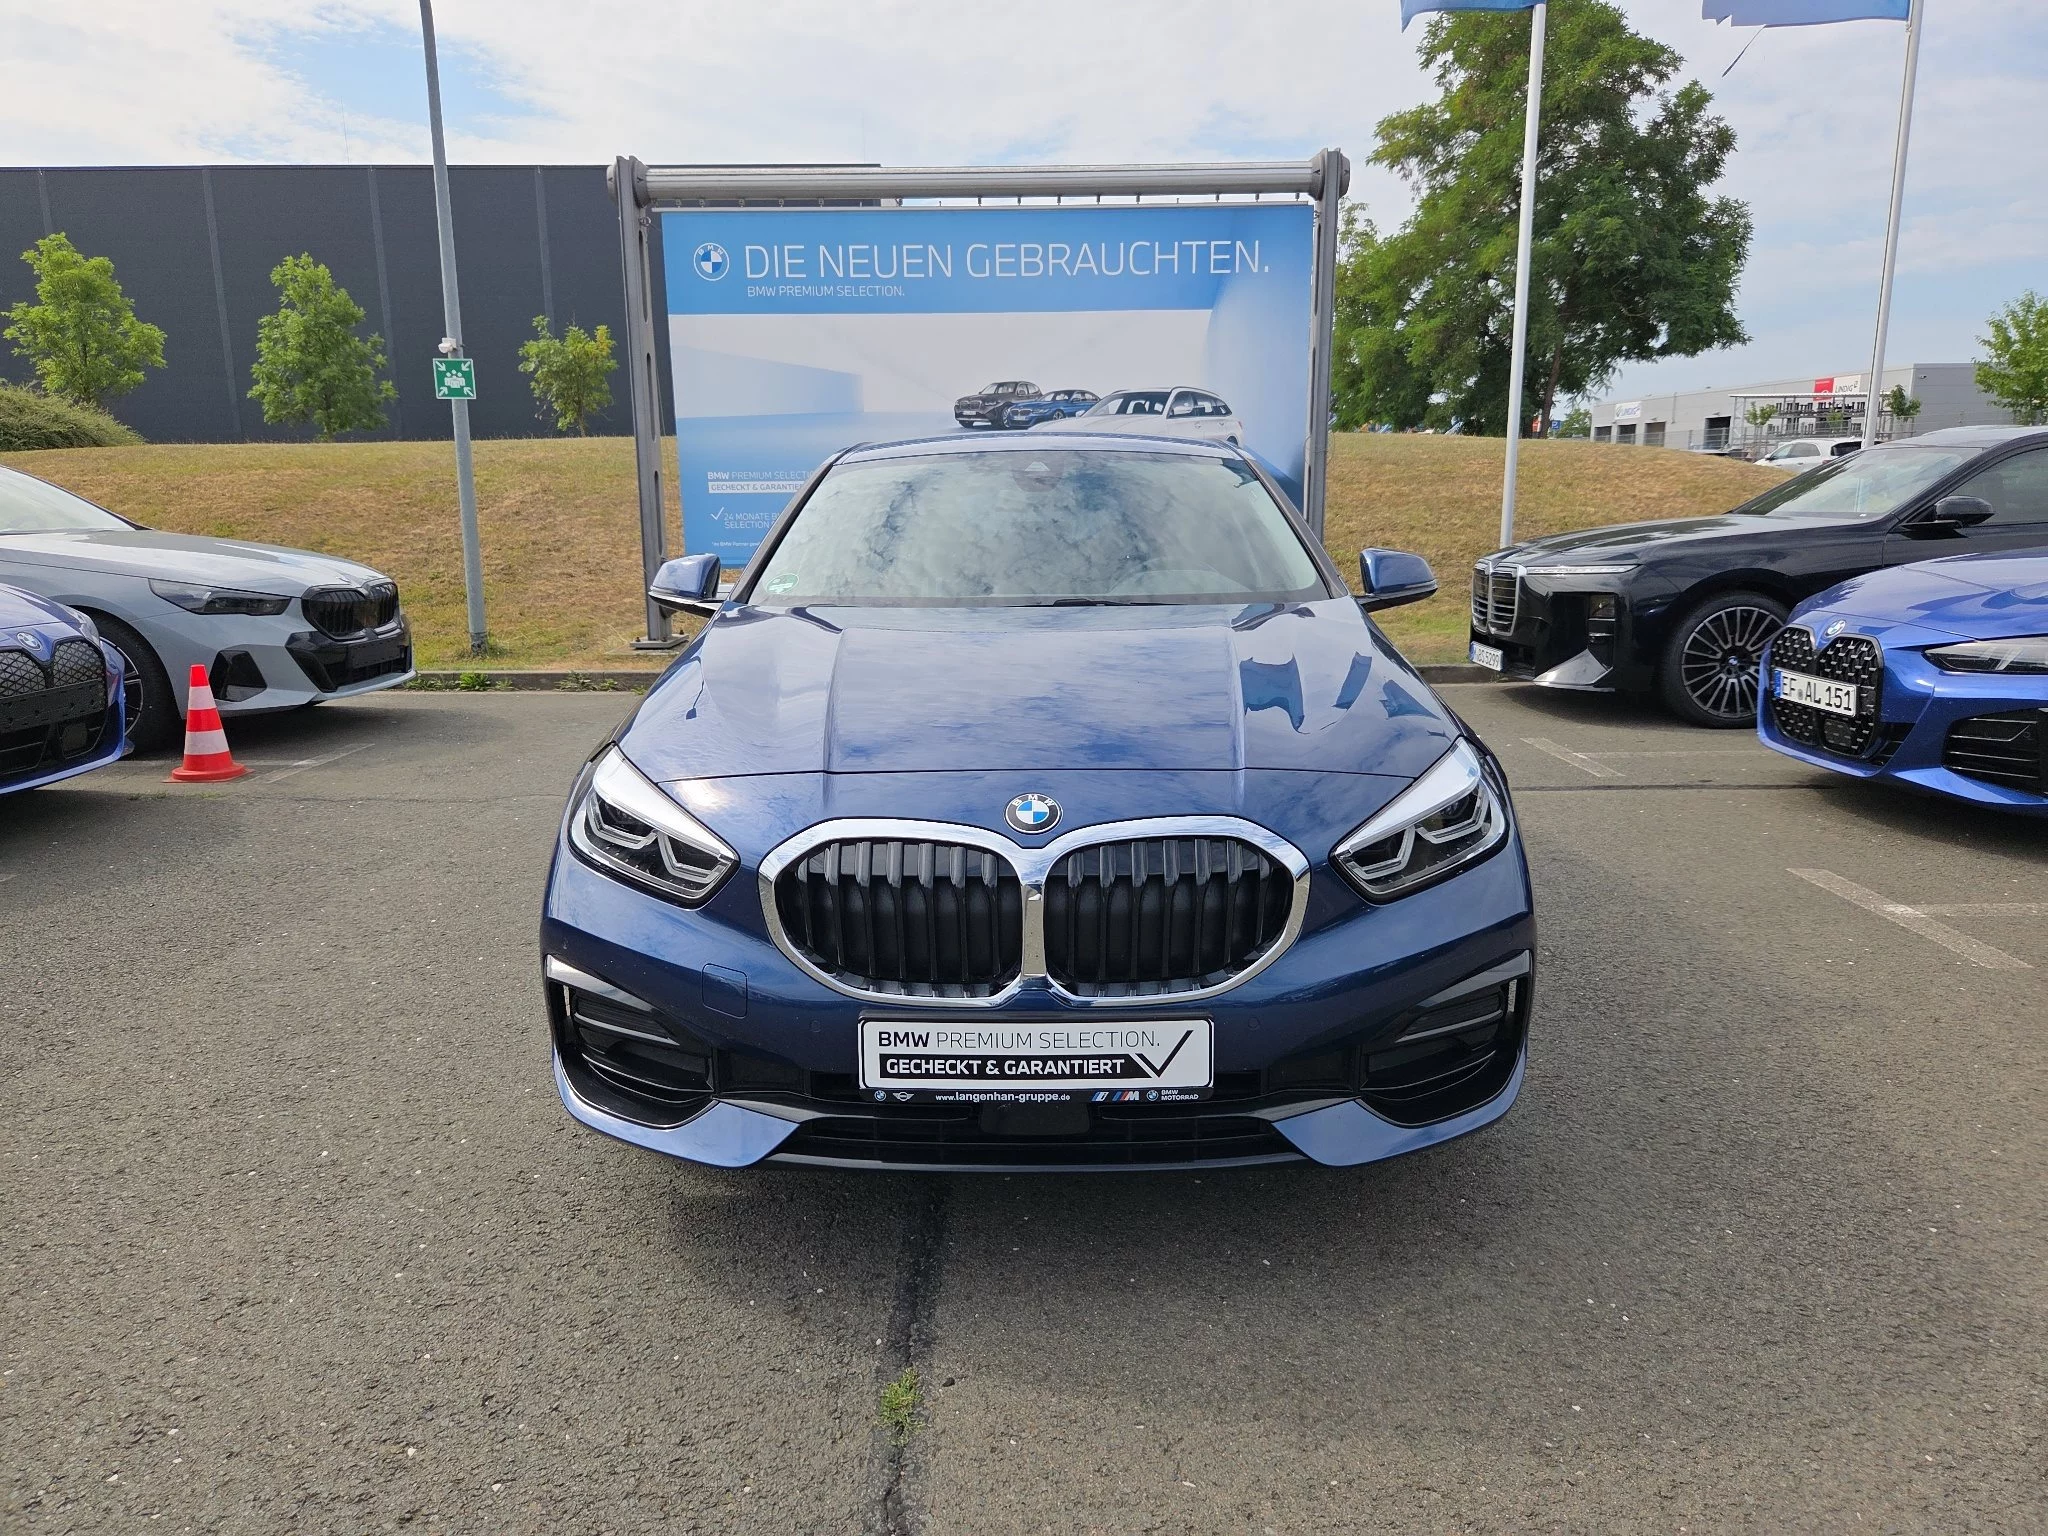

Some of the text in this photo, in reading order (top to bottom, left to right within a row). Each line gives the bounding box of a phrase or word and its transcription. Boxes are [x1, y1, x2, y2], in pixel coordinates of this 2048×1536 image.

[745, 240, 1270, 279] DIE NEUEN GEBRAUCHTEN.
[747, 285, 905, 297] BMW PREMIUM SELECTION.
[708, 472, 729, 480] BMW
[731, 471, 772, 480] PREMIUM
[736, 512, 769, 520] MONATE
[724, 520, 769, 529] SELECTION
[1783, 675, 1851, 712] EF AL 151
[1011, 794, 1056, 807] BMW
[878, 1030, 1160, 1049] BMW PREMIUM SELECTION.
[886, 1058, 1125, 1075] GECHECKT & GARANTIERT
[935, 1091, 1071, 1103] www.langenhan-gruppe.de
